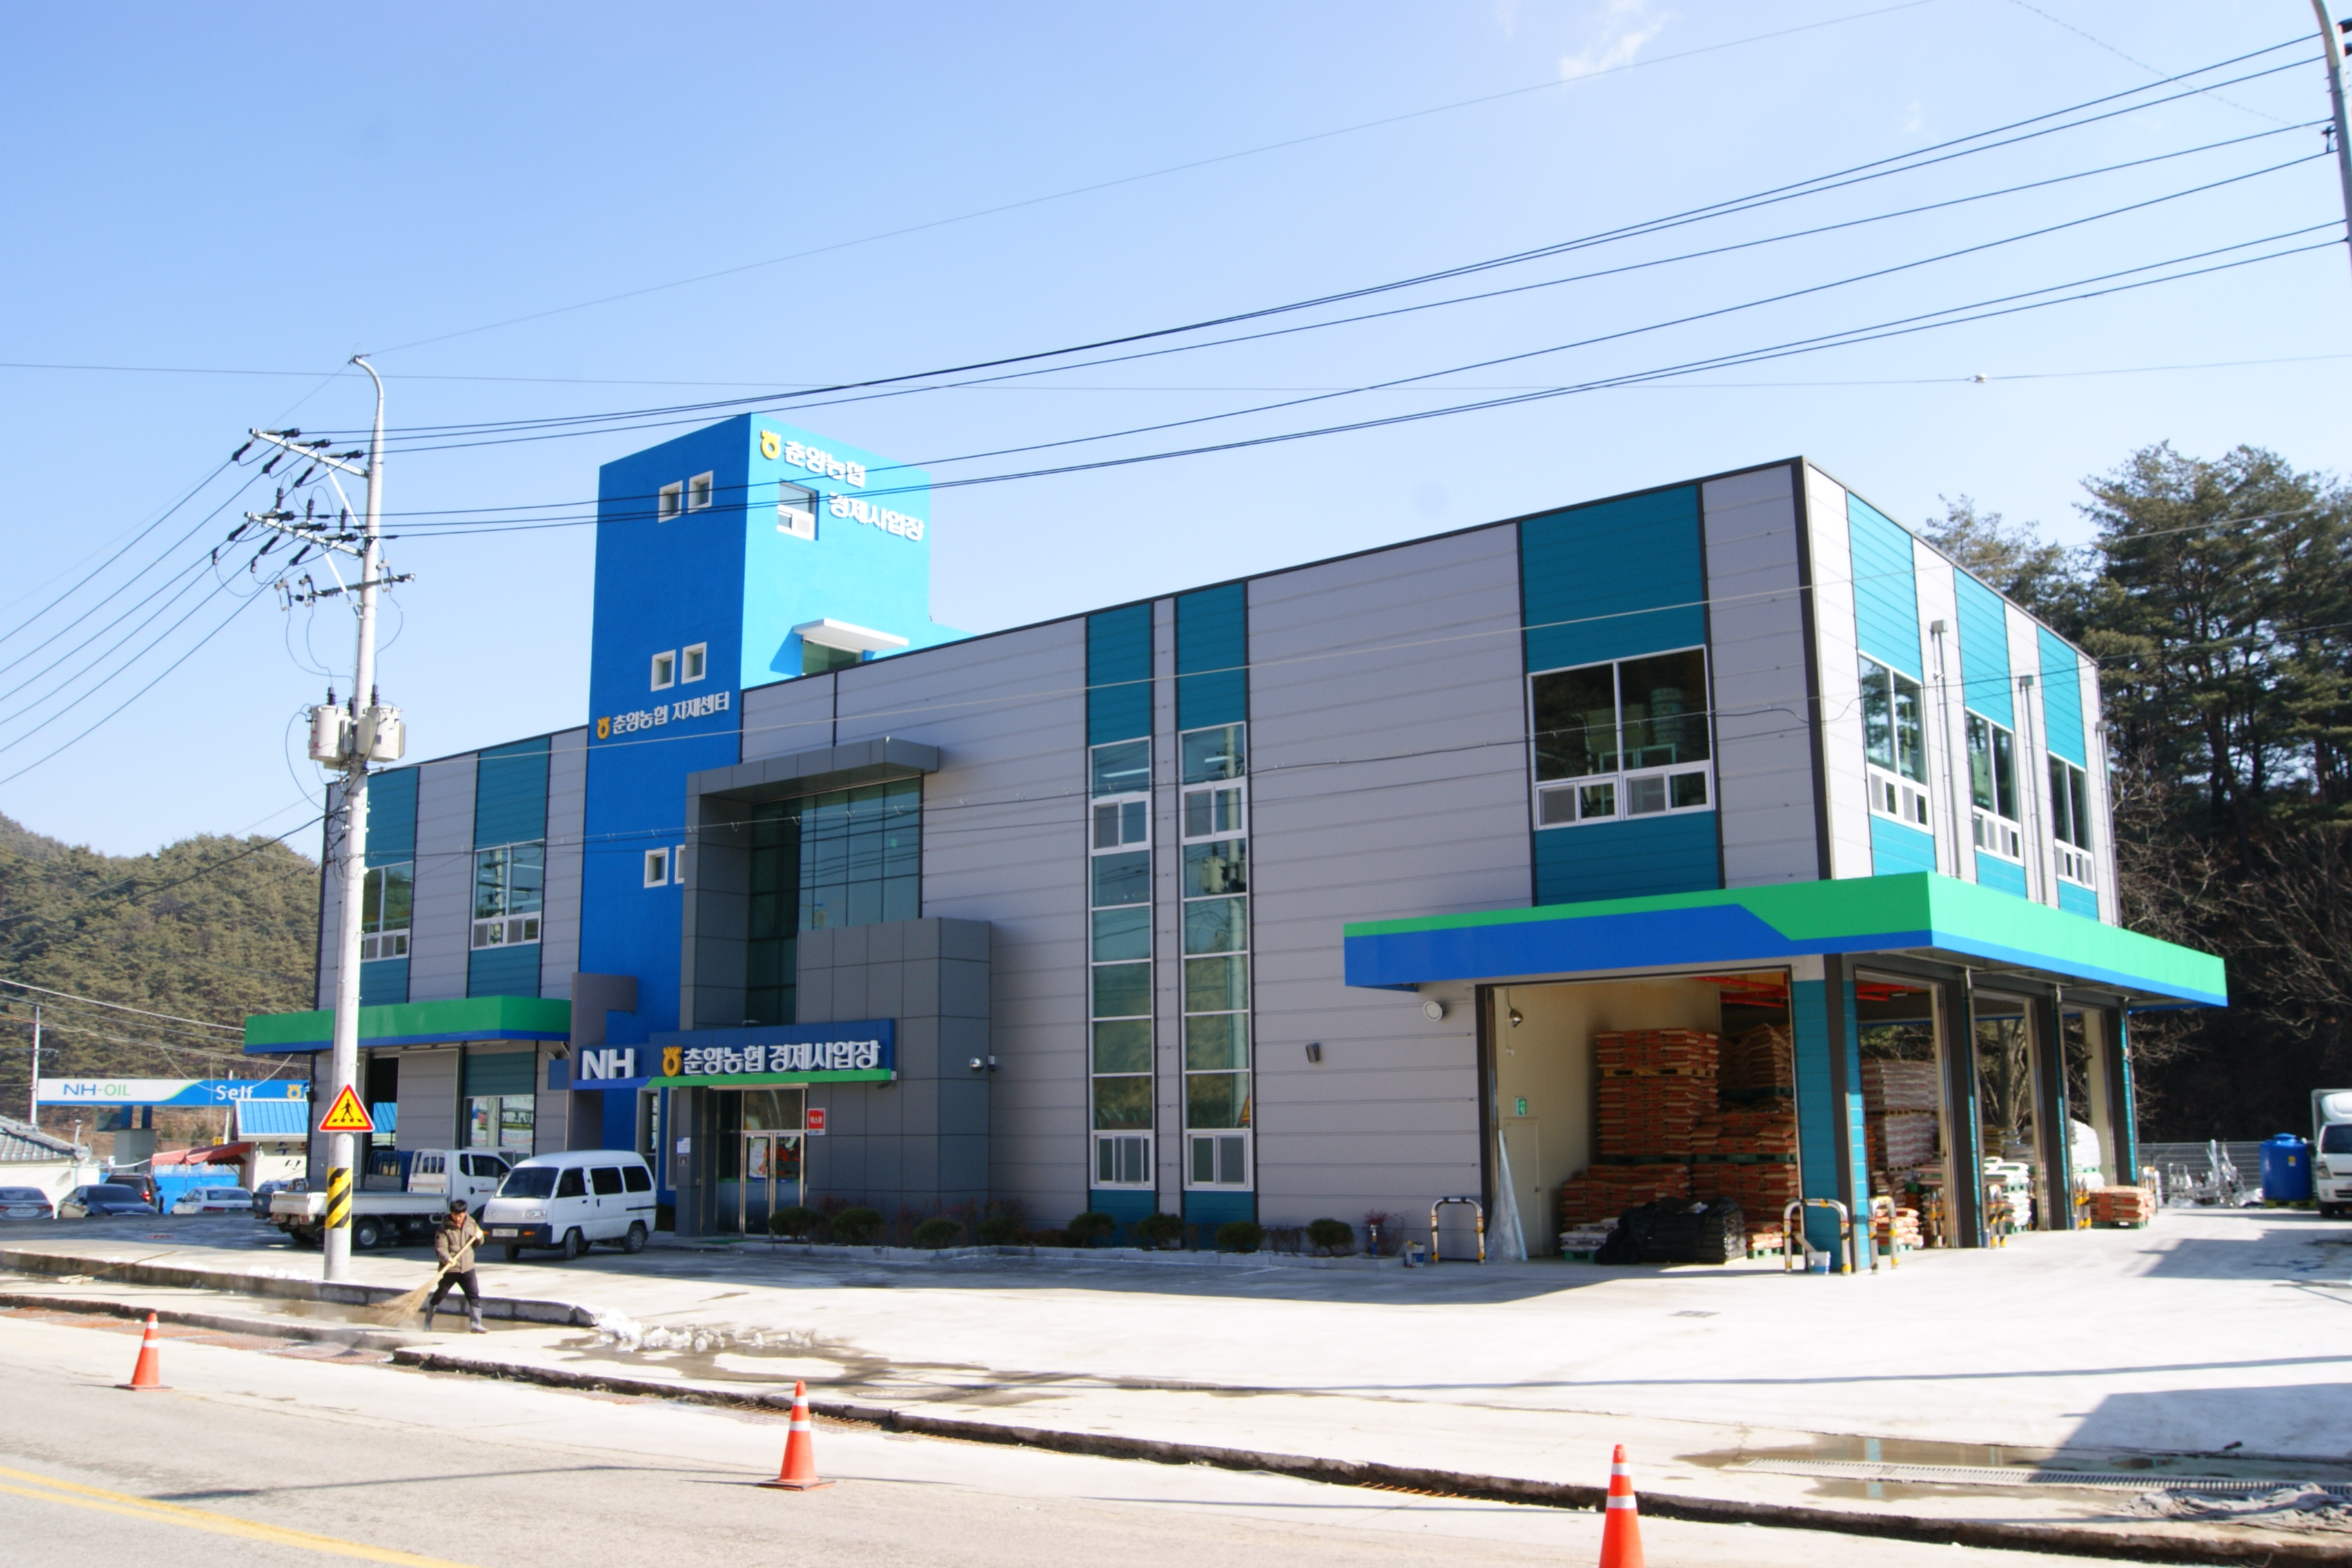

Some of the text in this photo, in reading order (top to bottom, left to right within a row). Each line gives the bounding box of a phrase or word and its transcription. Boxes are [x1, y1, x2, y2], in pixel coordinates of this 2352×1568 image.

[784, 440, 865, 488] 춘양농협
[828, 491, 925, 541] 경제사업장
[613, 691, 730, 734] 춘양농협 자재센터
[582, 1048, 634, 1080] NH
[683, 1040, 881, 1075] 춘양농협 경제사업장
[63, 1084, 131, 1096] NH-OIL
[216, 1085, 254, 1100] Self
